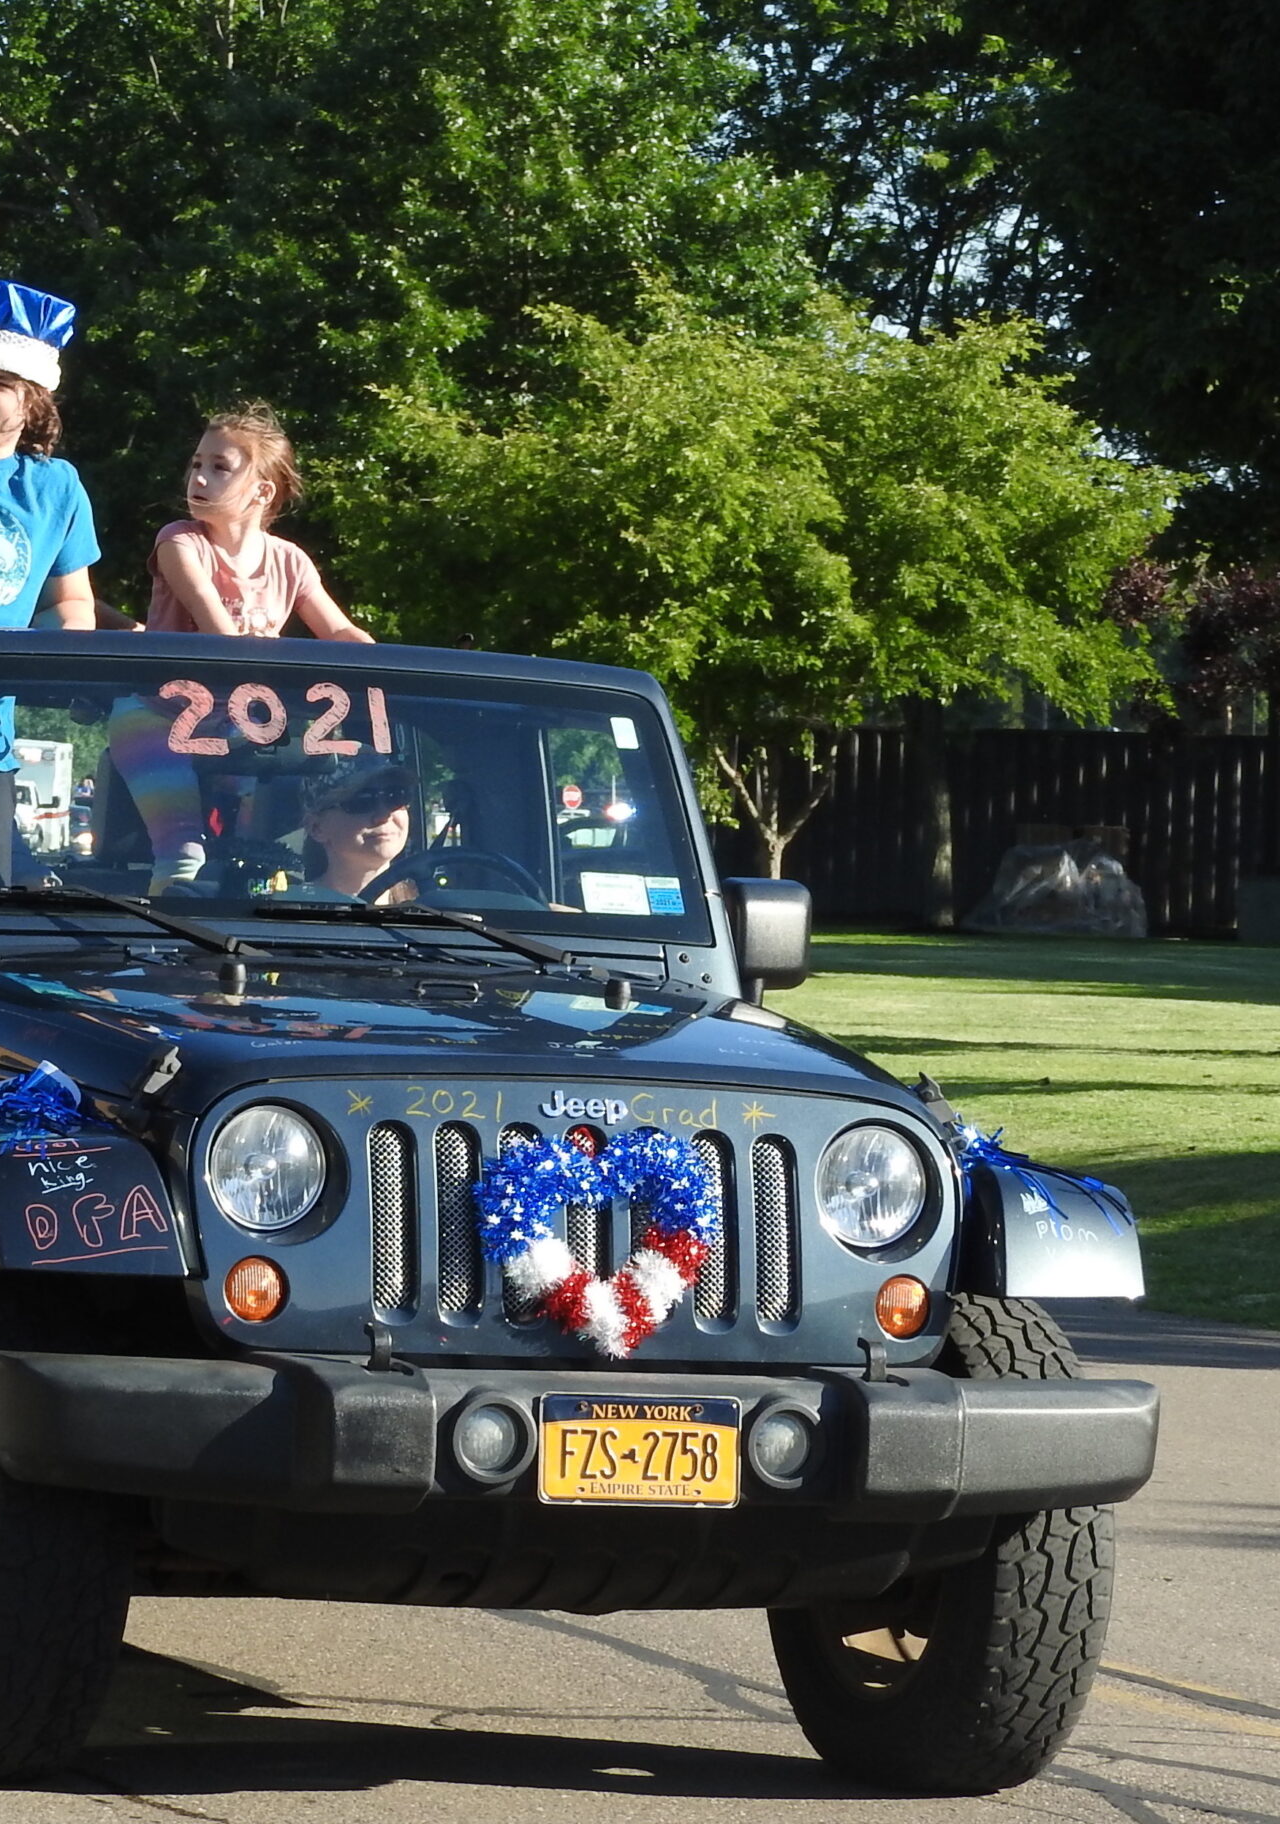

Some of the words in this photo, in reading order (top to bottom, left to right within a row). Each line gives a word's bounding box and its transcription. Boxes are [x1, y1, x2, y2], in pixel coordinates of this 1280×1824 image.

[159, 679, 392, 756] 2021
[406, 1085, 503, 1123] 2021
[541, 1089, 629, 1125] Jeep
[630, 1093, 718, 1129] Grad
[592, 1403, 639, 1420] NEW
[645, 1404, 692, 1422] YORK
[590, 1481, 644, 1496] EMPIRE
[648, 1483, 691, 1497] STATE
